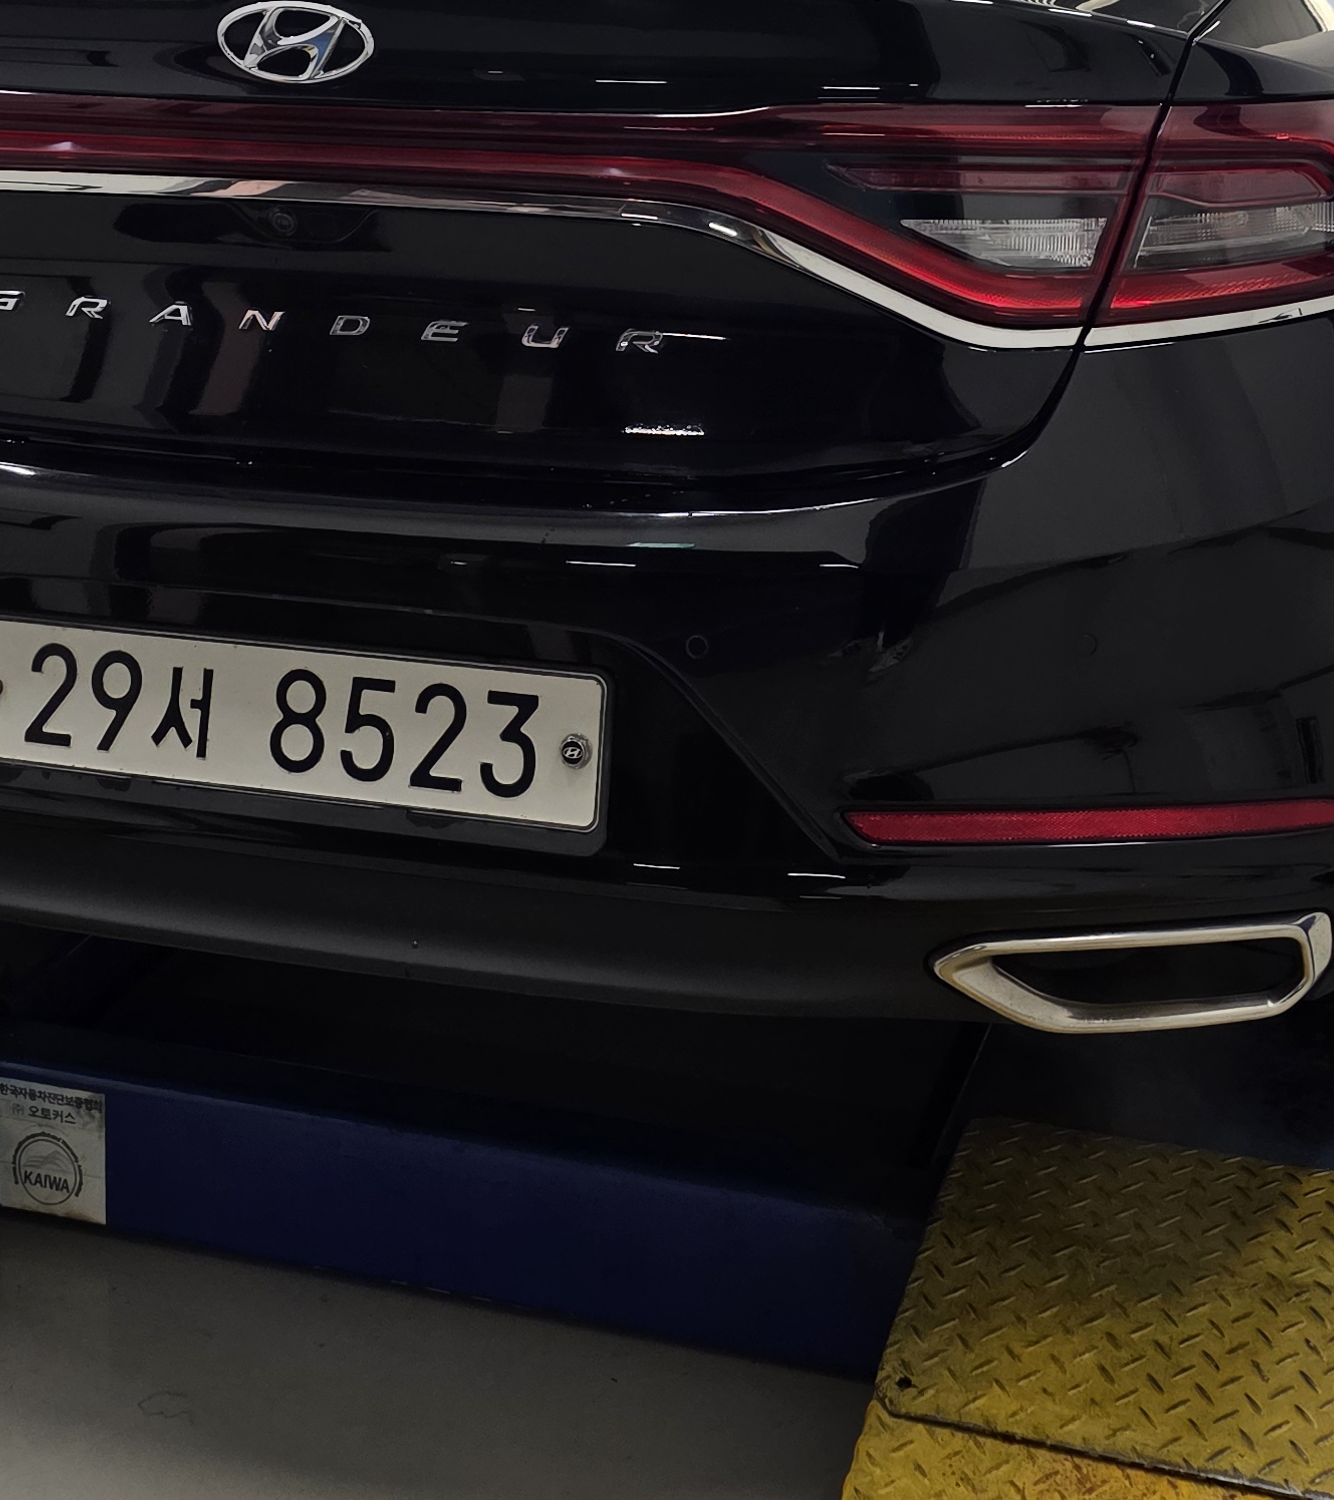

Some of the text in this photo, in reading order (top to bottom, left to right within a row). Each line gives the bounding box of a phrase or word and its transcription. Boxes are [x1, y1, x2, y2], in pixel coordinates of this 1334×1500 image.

[24, 642, 541, 798] 29서 8523
[28, 1105, 76, 1124] 오토커스
[23, 1170, 70, 1194] KAIWA
